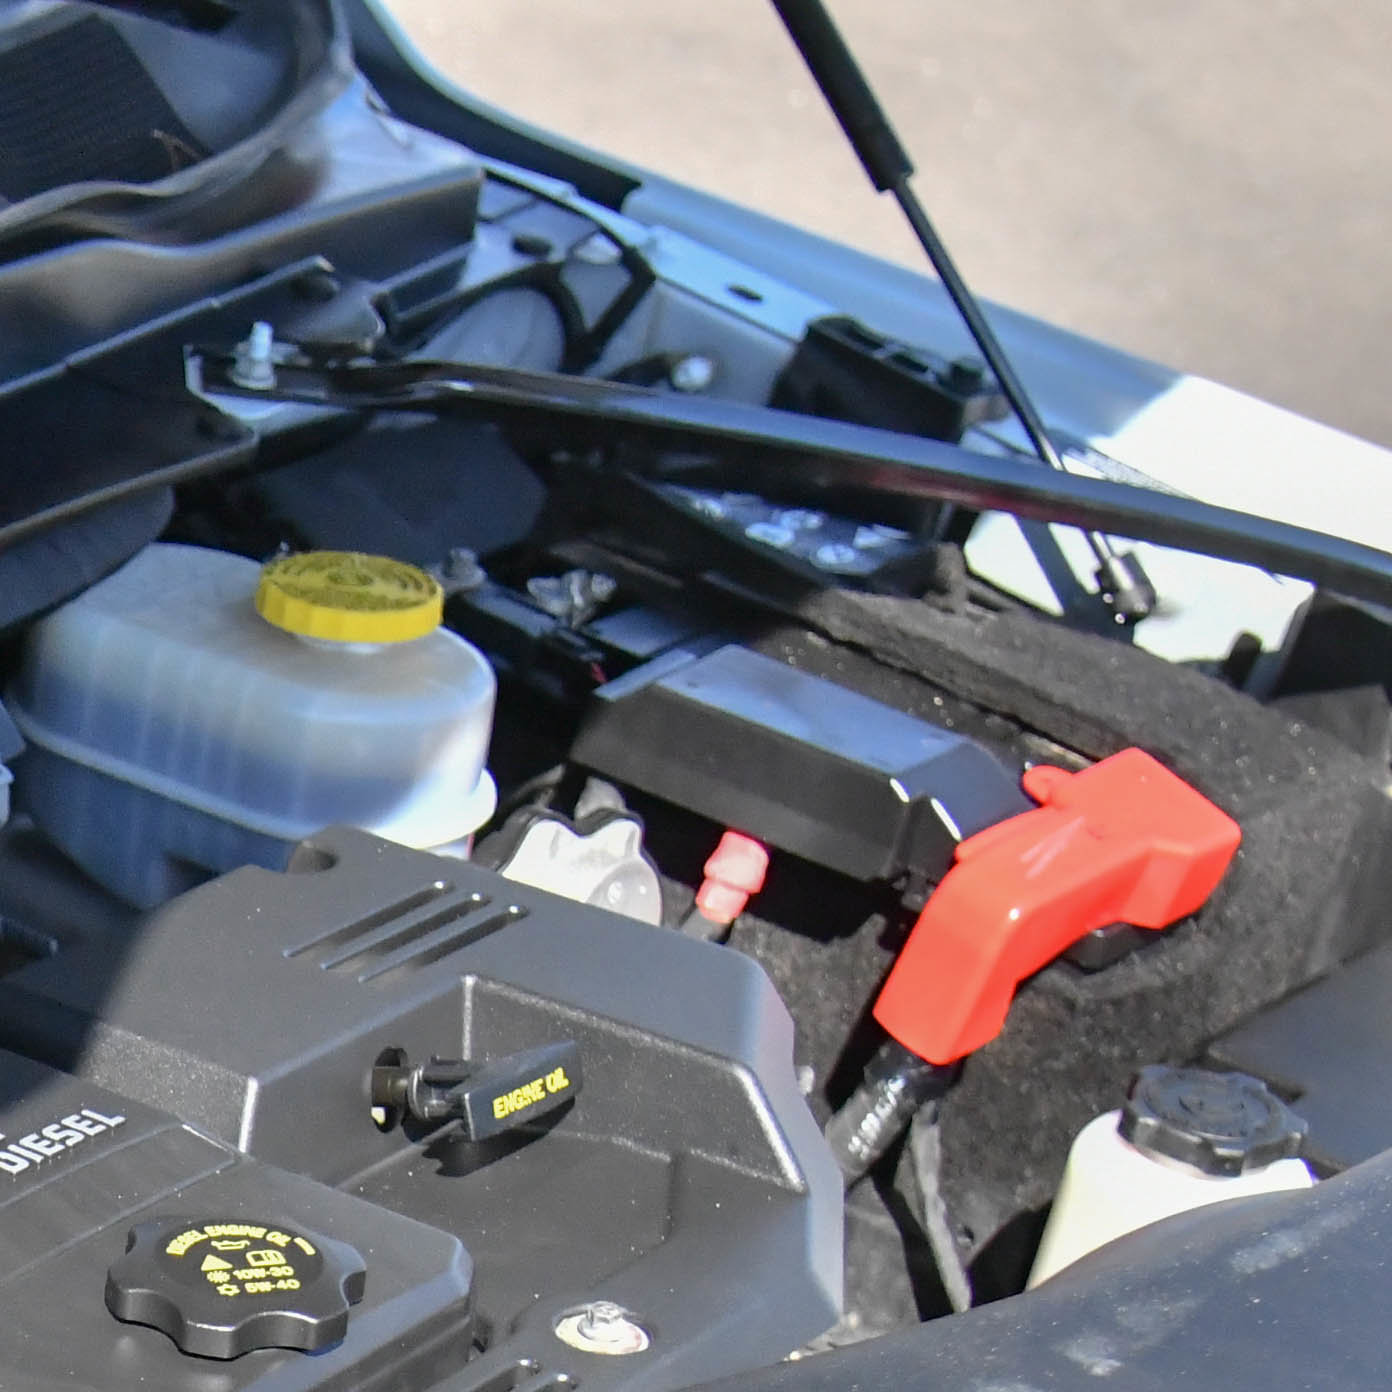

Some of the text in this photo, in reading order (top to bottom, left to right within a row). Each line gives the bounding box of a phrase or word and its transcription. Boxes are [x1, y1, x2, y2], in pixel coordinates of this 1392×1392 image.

[492, 1067, 569, 1119] ENGINE OIL
[232, 1265, 295, 1280] 10W-30
